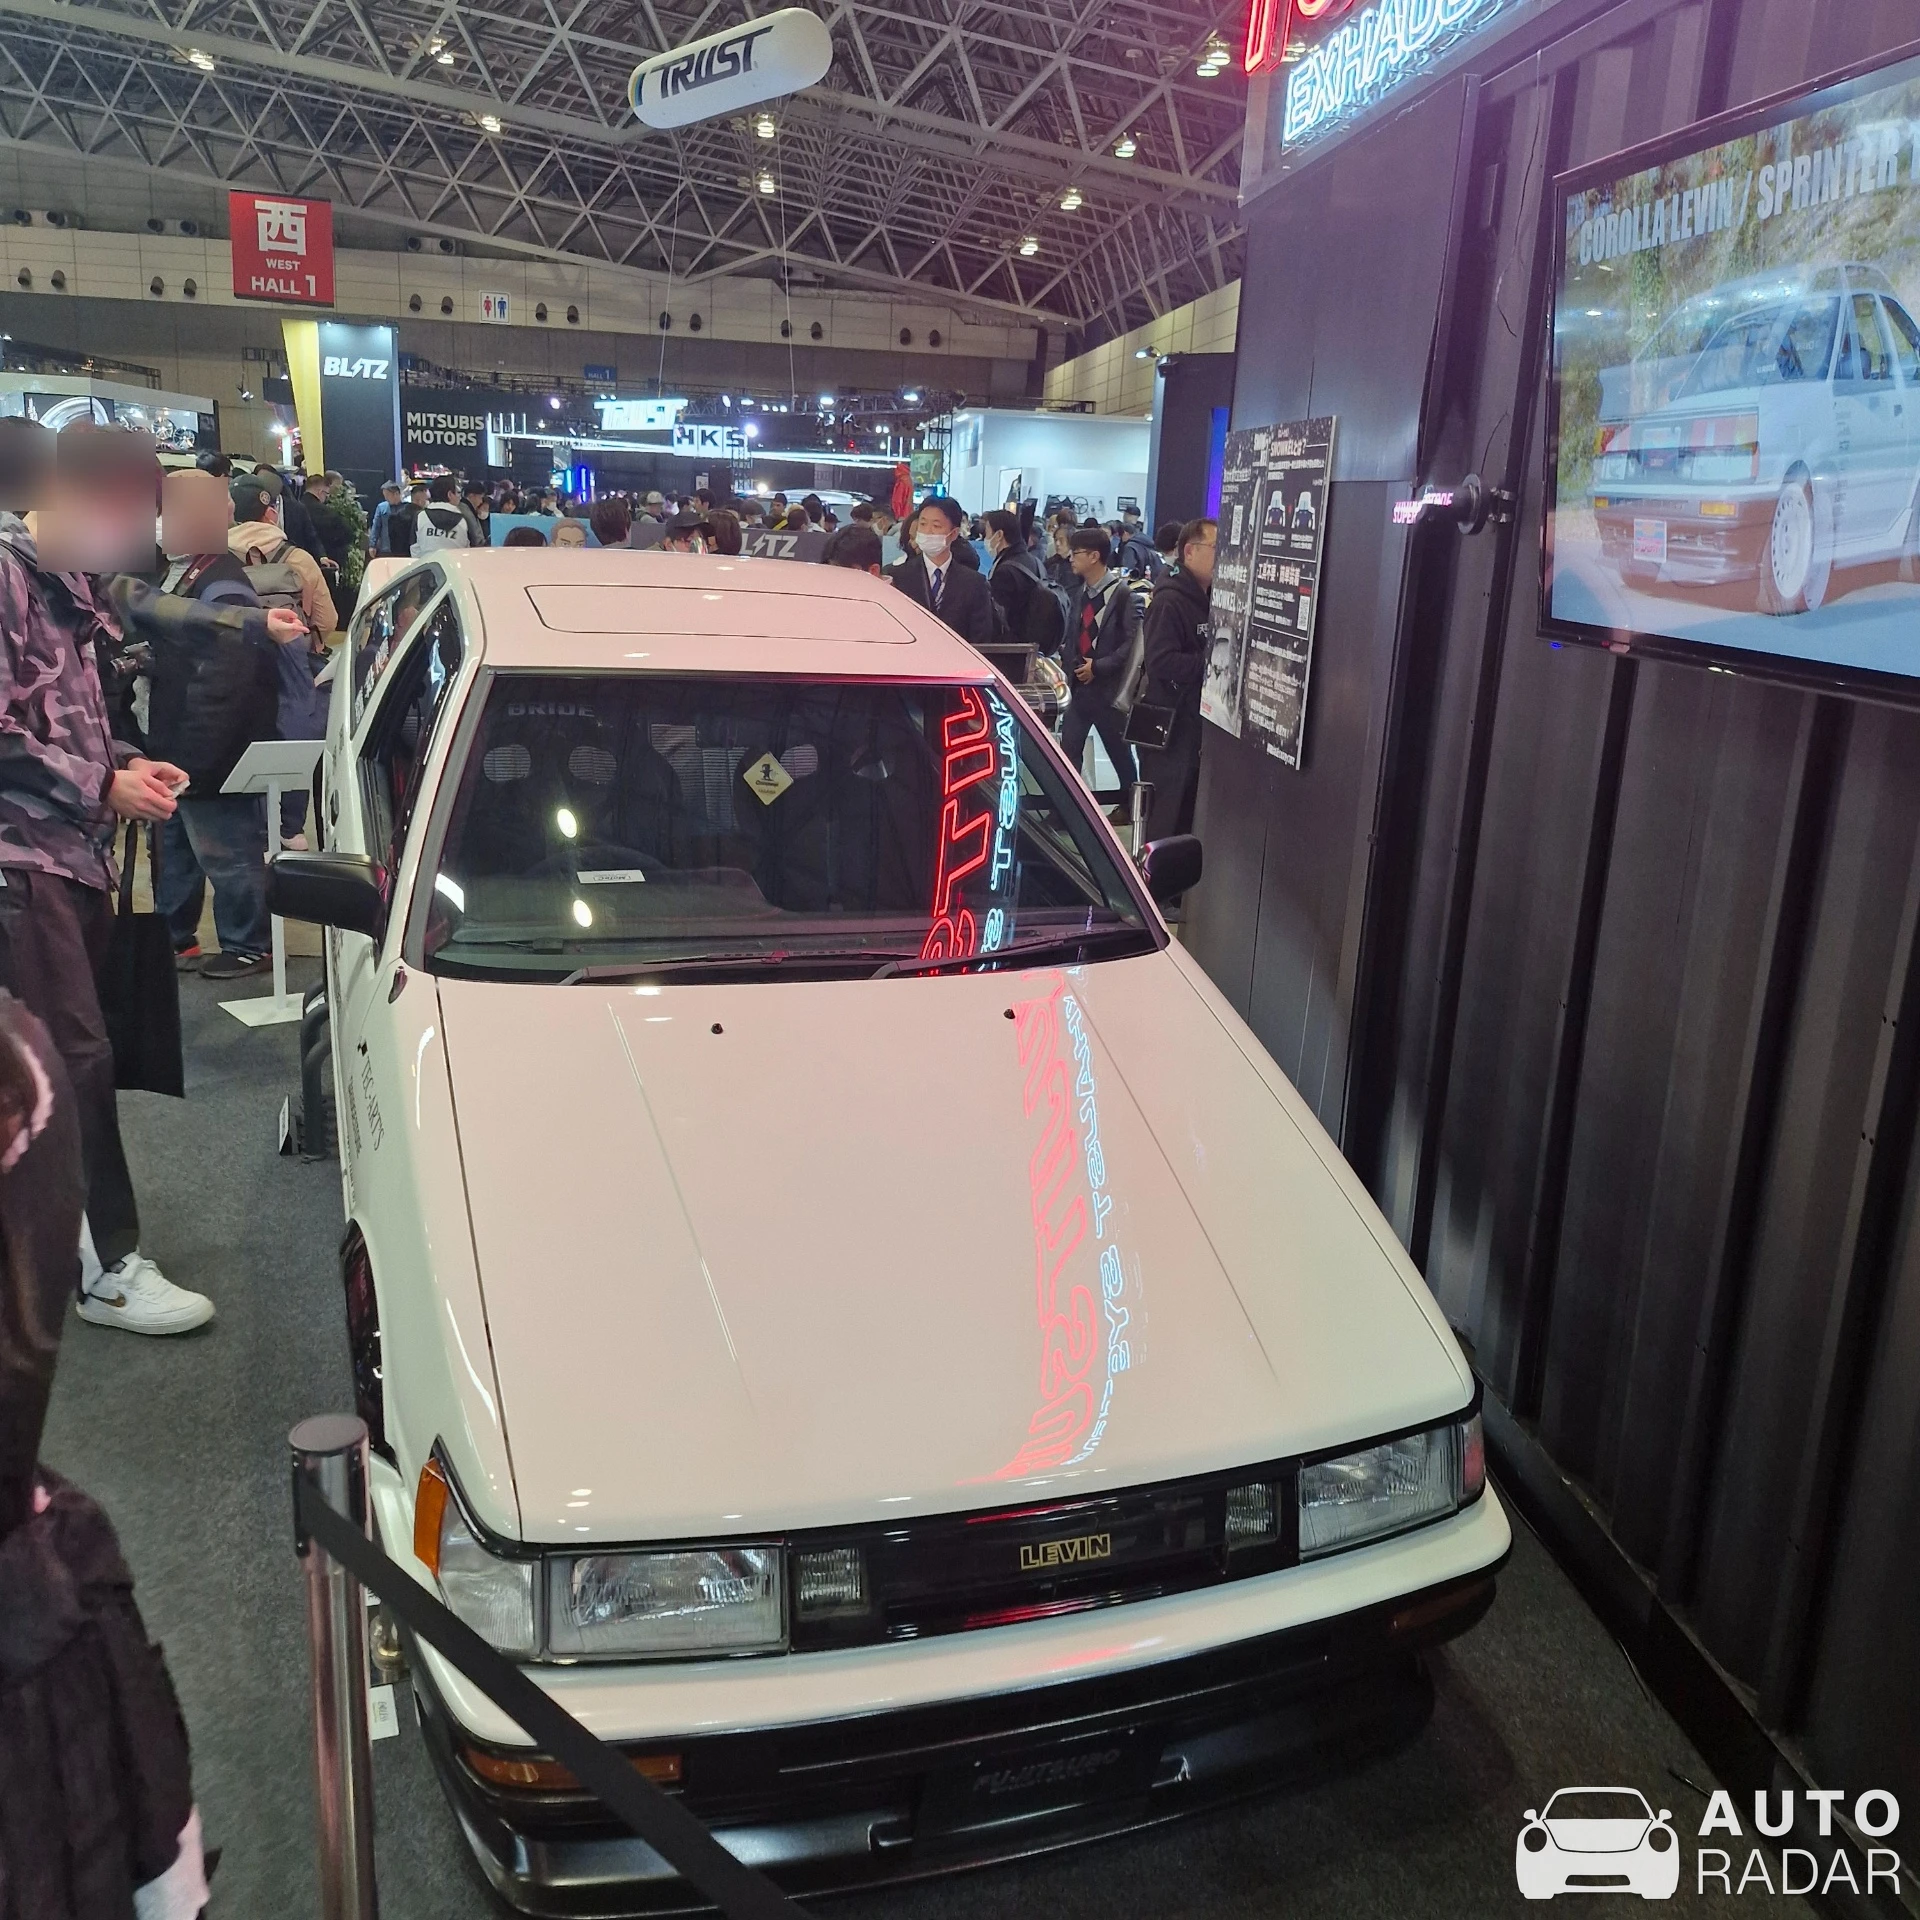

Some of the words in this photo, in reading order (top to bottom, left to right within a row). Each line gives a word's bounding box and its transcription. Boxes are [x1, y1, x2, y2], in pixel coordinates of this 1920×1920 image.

[650, 25, 774, 99] TRUST
[1579, 199, 1665, 266] COROLLA
[1670, 177, 1734, 242] LEVIN
[1737, 170, 1753, 226] /
[1757, 127, 1900, 220] SPRINTER
[254, 199, 307, 256] 西
[266, 258, 301, 271] WEST
[251, 276, 302, 295] HALL
[305, 275, 316, 297] 1
[323, 356, 389, 380] BLITZ
[407, 411, 485, 431] MITSUBIS
[407, 429, 477, 447] MOTORS
[676, 427, 746, 448] HKS
[426, 528, 457, 539] BLITZ
[739, 532, 799, 558] LITZ
[507, 702, 595, 717] BRIDE
[1020, 1533, 1111, 1570] LEVIN
